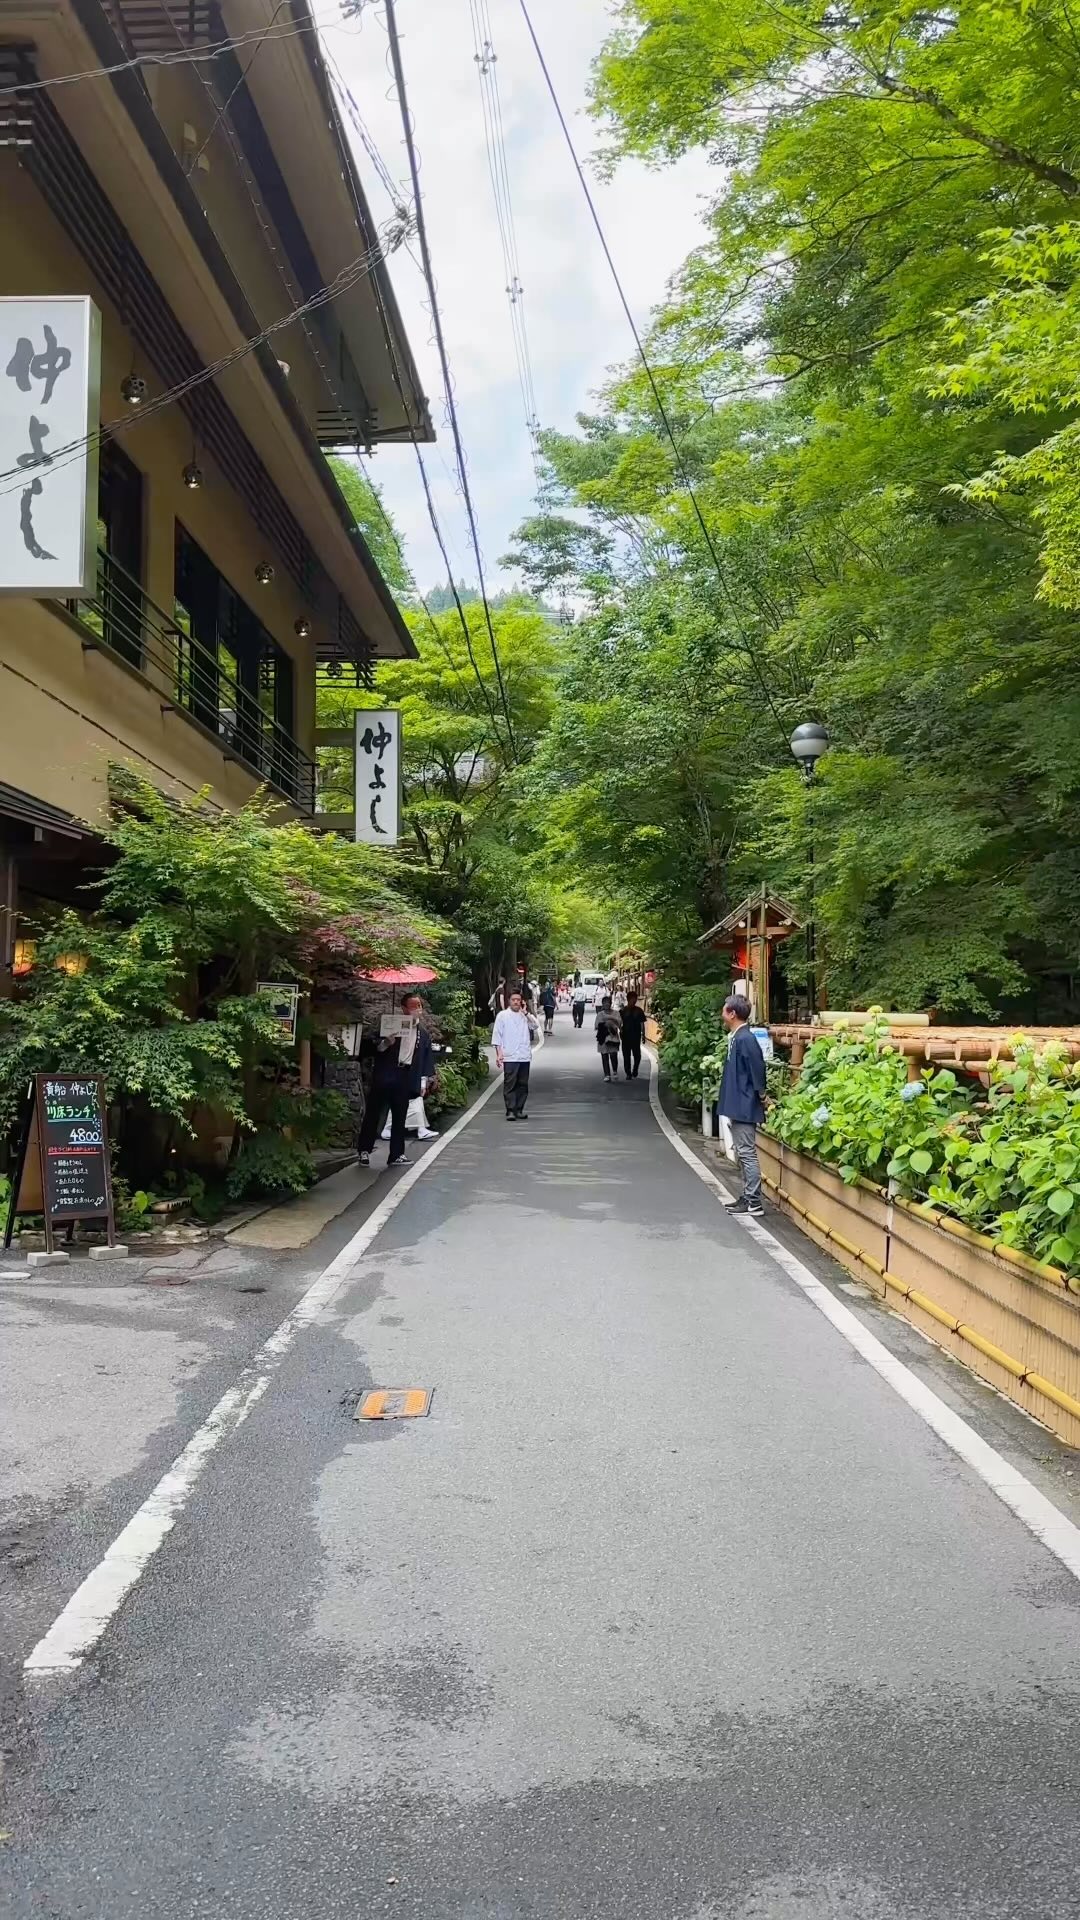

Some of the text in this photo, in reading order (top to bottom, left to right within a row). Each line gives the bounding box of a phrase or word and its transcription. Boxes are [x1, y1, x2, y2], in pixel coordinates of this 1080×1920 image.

[6, 324, 71, 560] 仲よし
[360, 721, 391, 834] 仲よし
[46, 1081, 92, 1096] 貴船 仲よし
[47, 1105, 91, 1119] 川床ランチ
